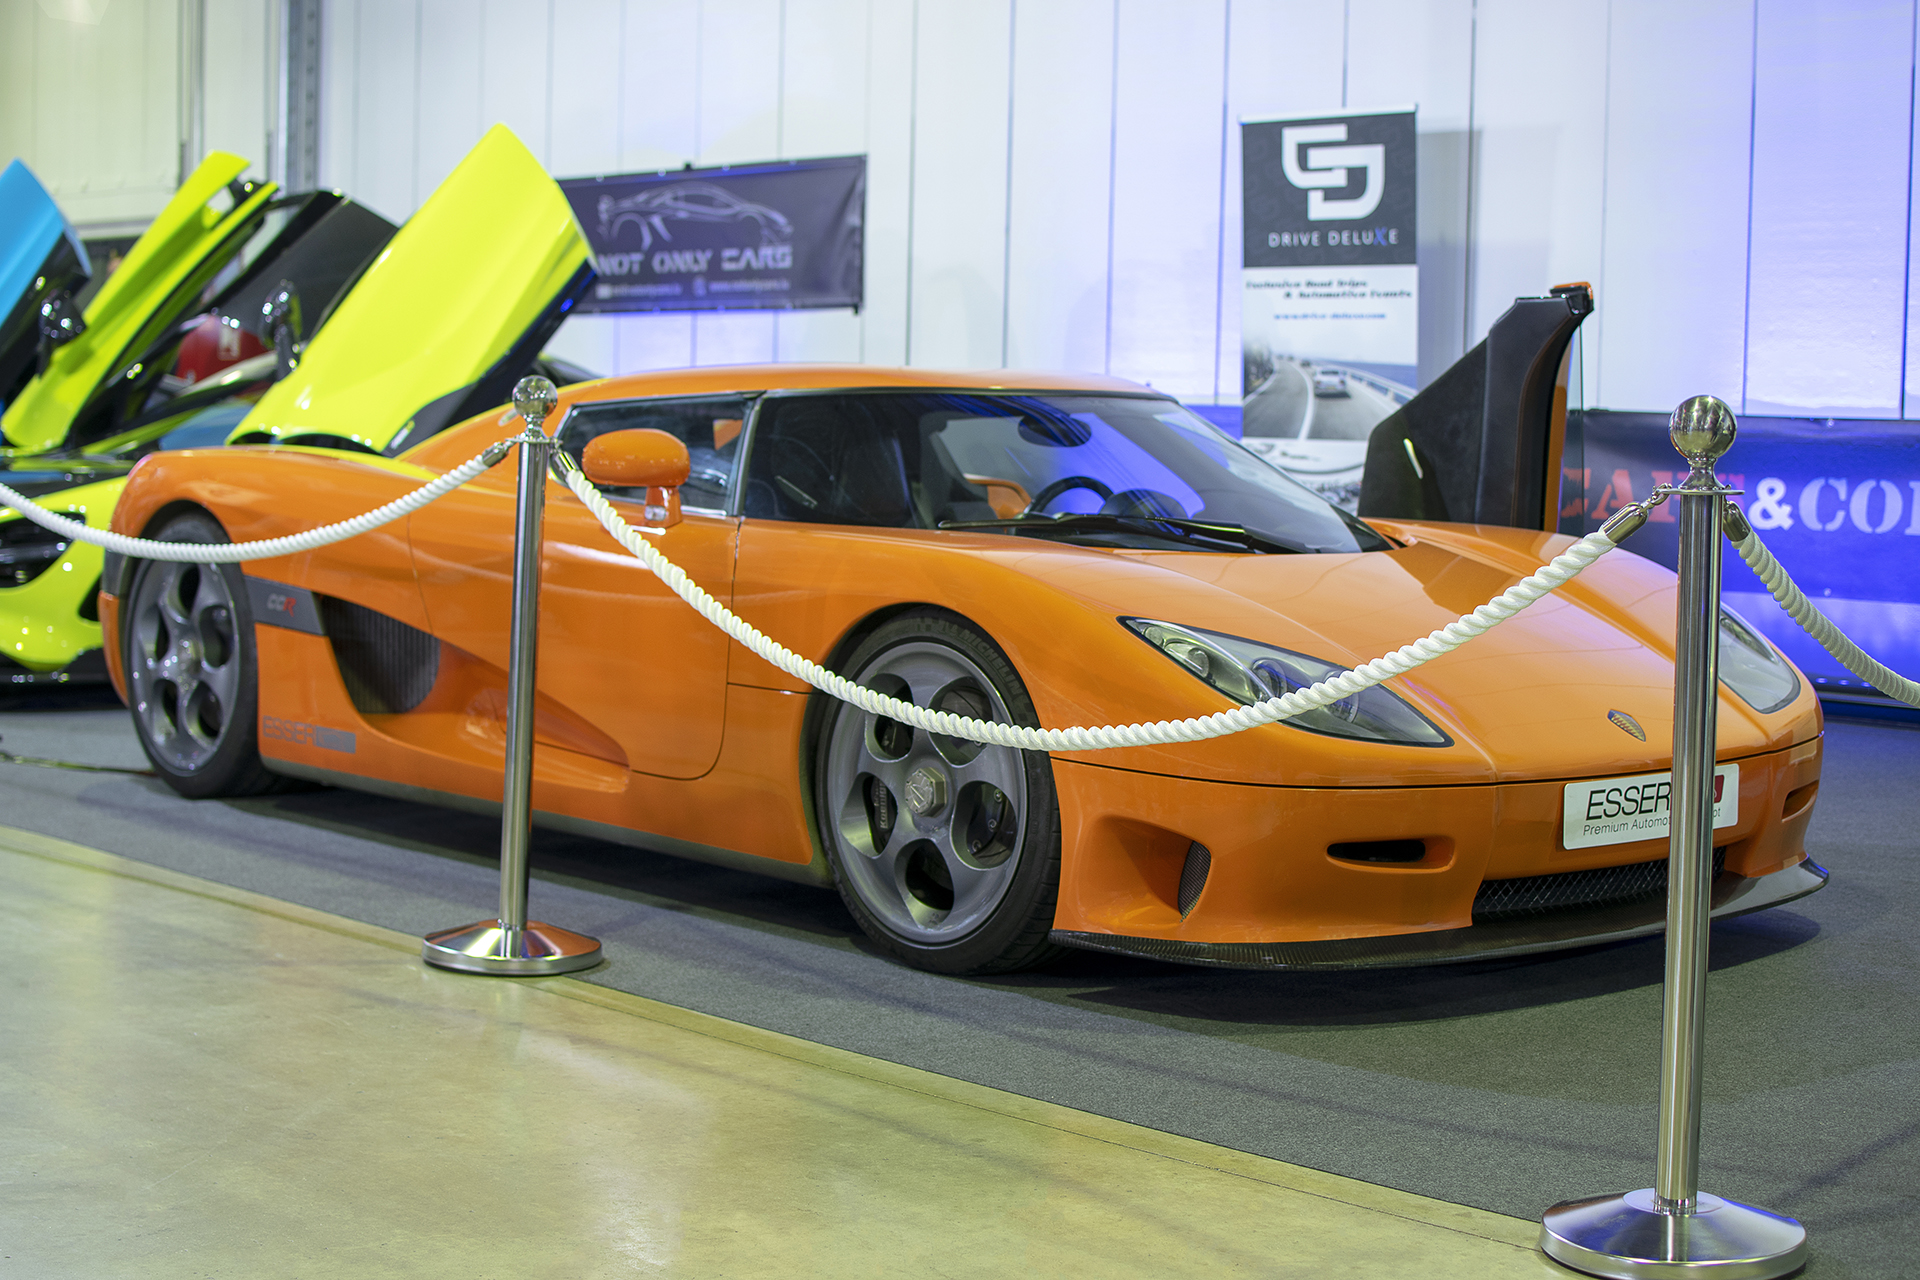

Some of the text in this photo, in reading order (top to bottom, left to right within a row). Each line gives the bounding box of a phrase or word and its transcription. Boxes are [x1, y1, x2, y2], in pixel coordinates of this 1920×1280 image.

[1268, 227, 1399, 248] DRIVE DELUXE
[597, 244, 793, 276] NOT ONLY CARS
[267, 593, 297, 618] CCR
[959, 628, 1024, 697] MICHELIN
[1586, 781, 1672, 821] ESSER
[1583, 821, 1629, 836] Premium
